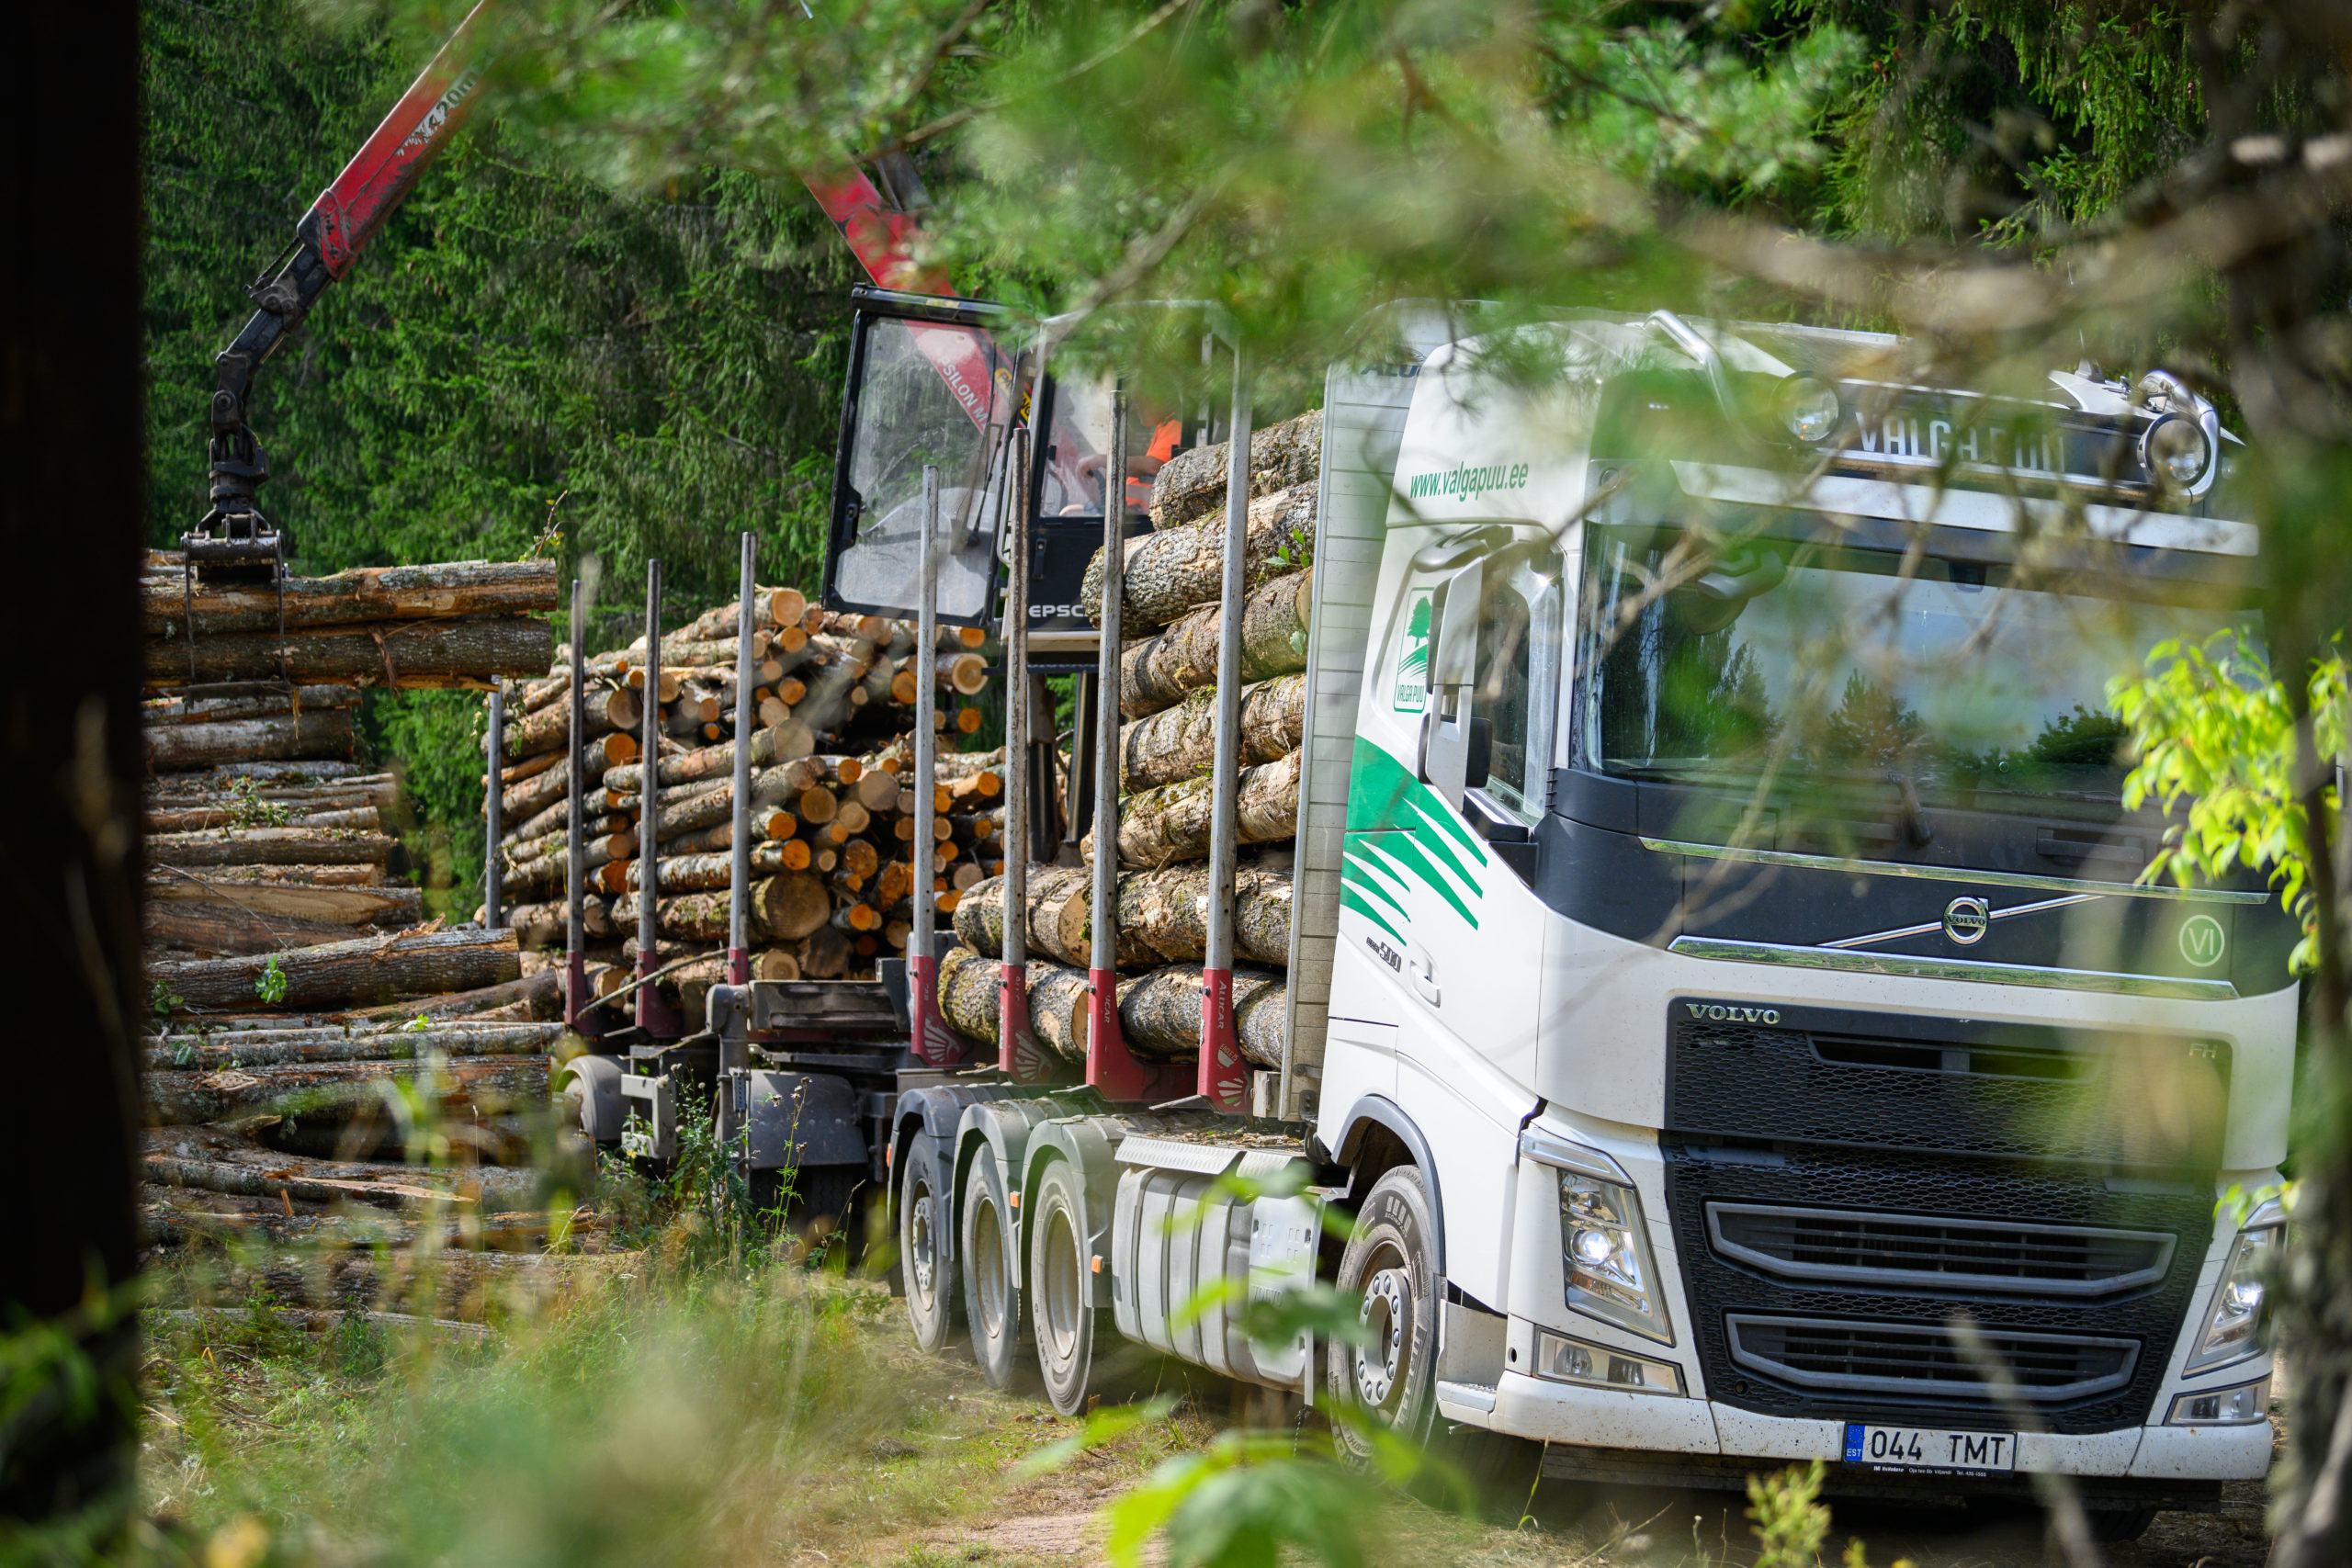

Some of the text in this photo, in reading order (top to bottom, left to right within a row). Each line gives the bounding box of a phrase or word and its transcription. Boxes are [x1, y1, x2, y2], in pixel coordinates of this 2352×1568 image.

[937, 355, 978, 408] PSILON
[1361, 364, 1421, 378] ALU
[1410, 460, 1529, 502] www.valgapuu.ee
[1028, 604, 1089, 617] EPSC
[1412, 685, 1425, 703] PUU
[1947, 916, 1985, 926] VOLVO
[2188, 927, 2214, 956] VI
[1217, 980, 1227, 1030] ALUCAR
[1686, 1003, 1781, 1024] VOLVO
[2188, 1043, 2218, 1059] FH
[1847, 1430, 2007, 1465] EST 044 TMT
